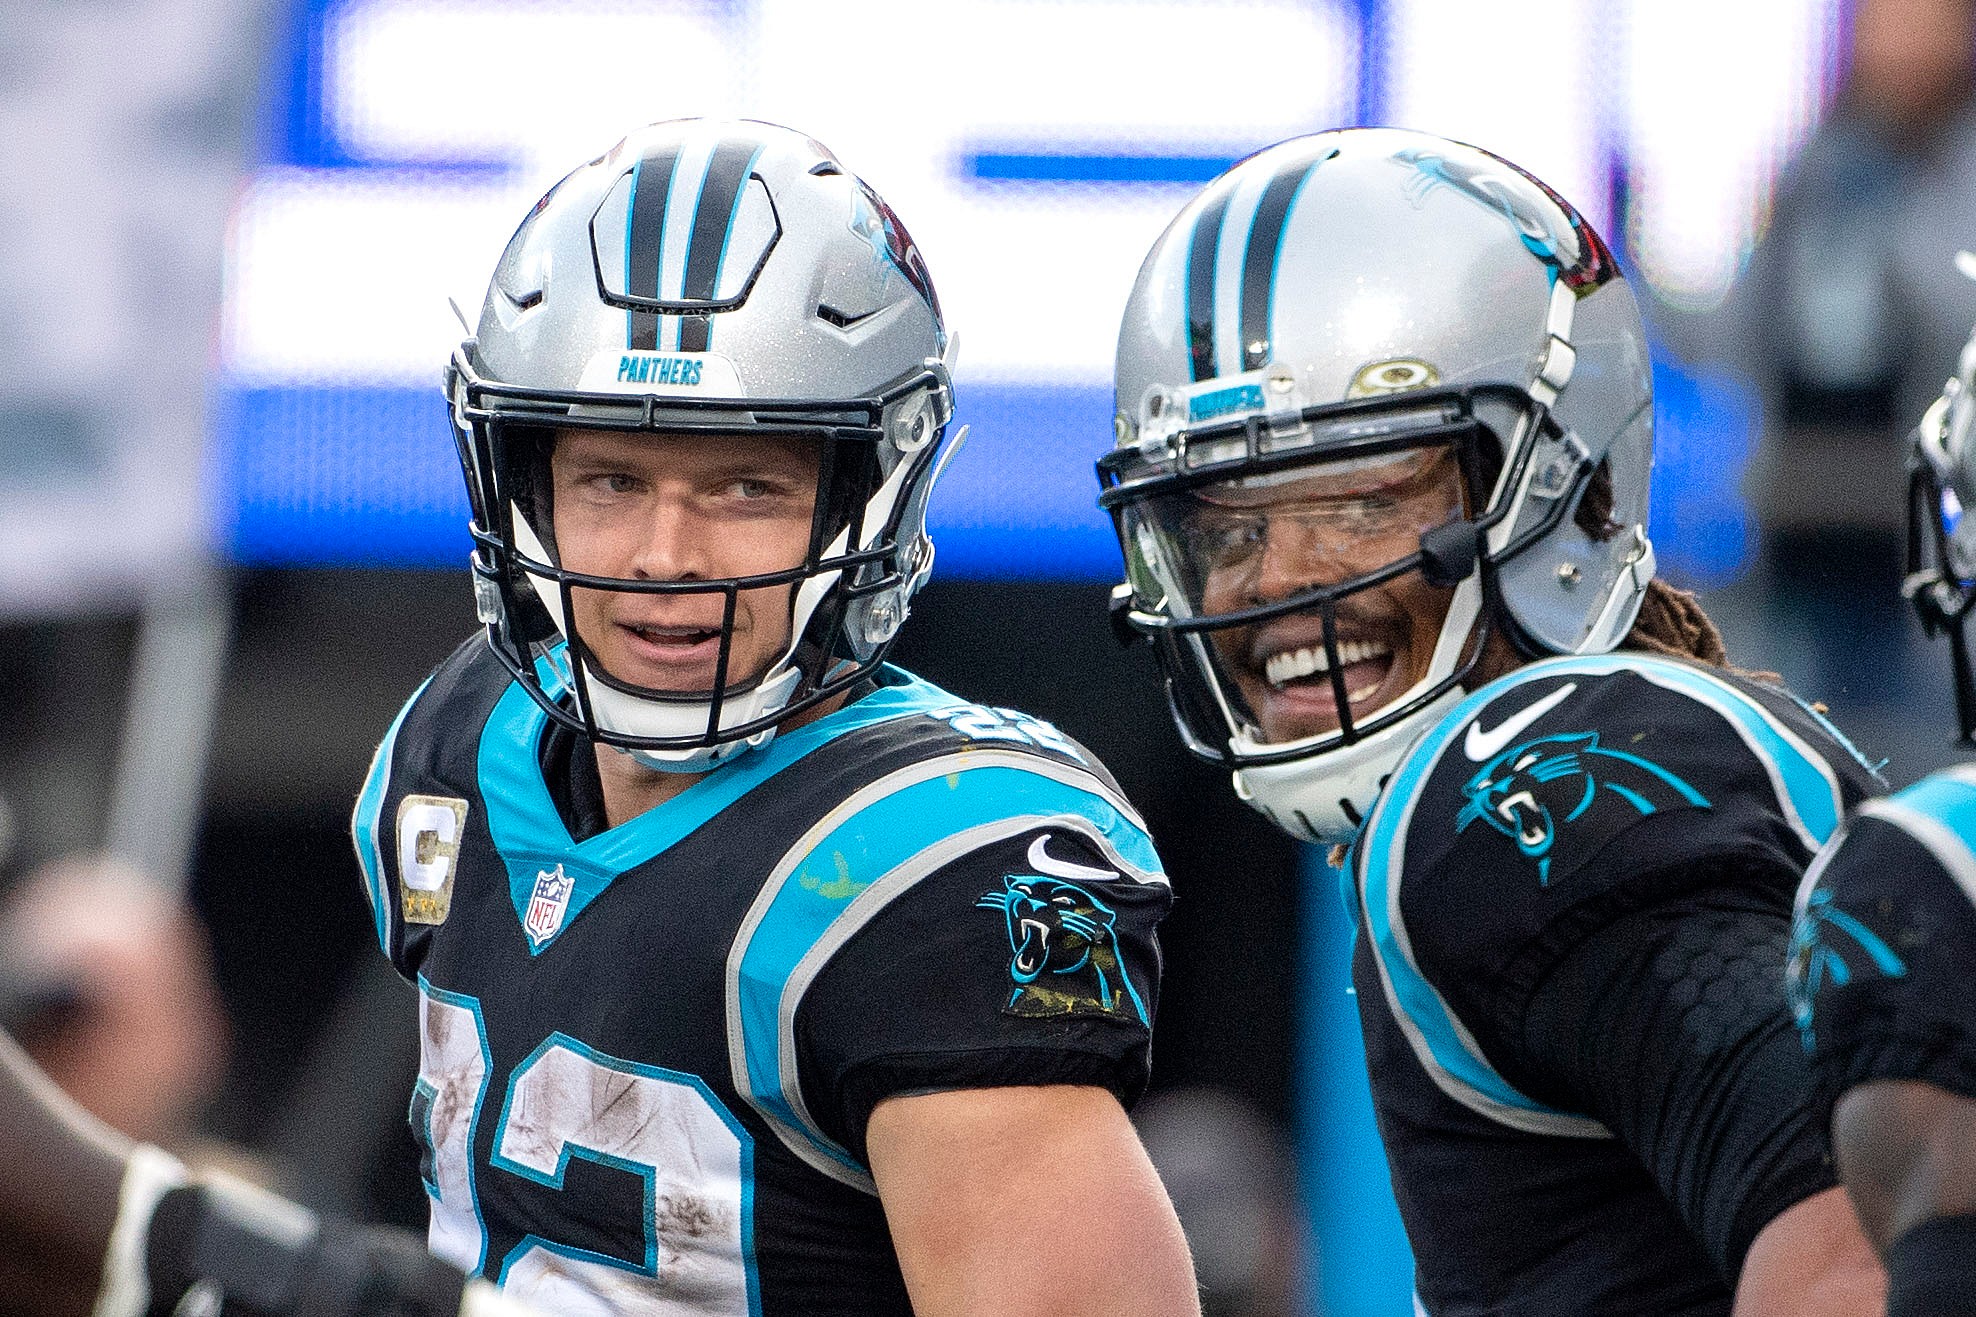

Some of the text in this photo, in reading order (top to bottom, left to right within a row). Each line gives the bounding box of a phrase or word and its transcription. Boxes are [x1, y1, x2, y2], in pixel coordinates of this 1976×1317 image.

[617, 355, 704, 385] PANTHERS
[400, 804, 457, 892] C
[531, 900, 557, 931] NFL
